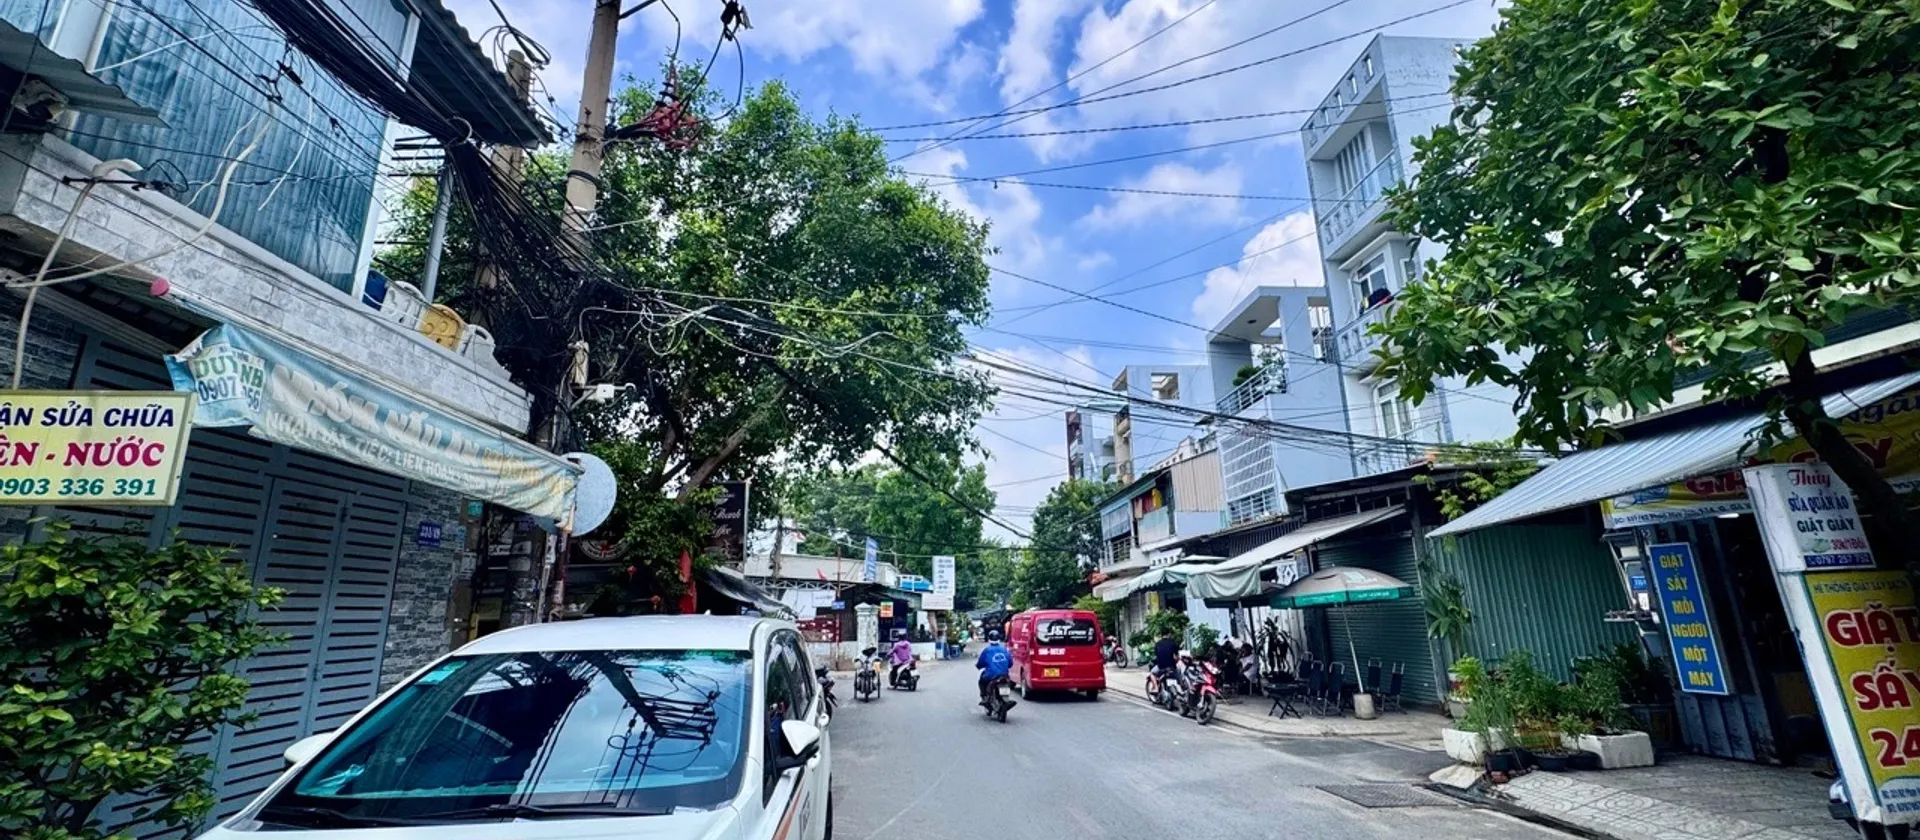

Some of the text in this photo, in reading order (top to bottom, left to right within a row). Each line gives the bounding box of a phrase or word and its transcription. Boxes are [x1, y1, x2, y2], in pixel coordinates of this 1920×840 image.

[41, 401, 93, 427] SỬA
[104, 403, 174, 427] CHỮA
[63, 435, 165, 467] NƯỚC
[58, 478, 104, 495] 336
[112, 478, 156, 495] 391
[1797, 517, 1824, 537] GIẶT
[1047, 625, 1072, 636] J&T
[1825, 601, 1919, 652] GIẶT
